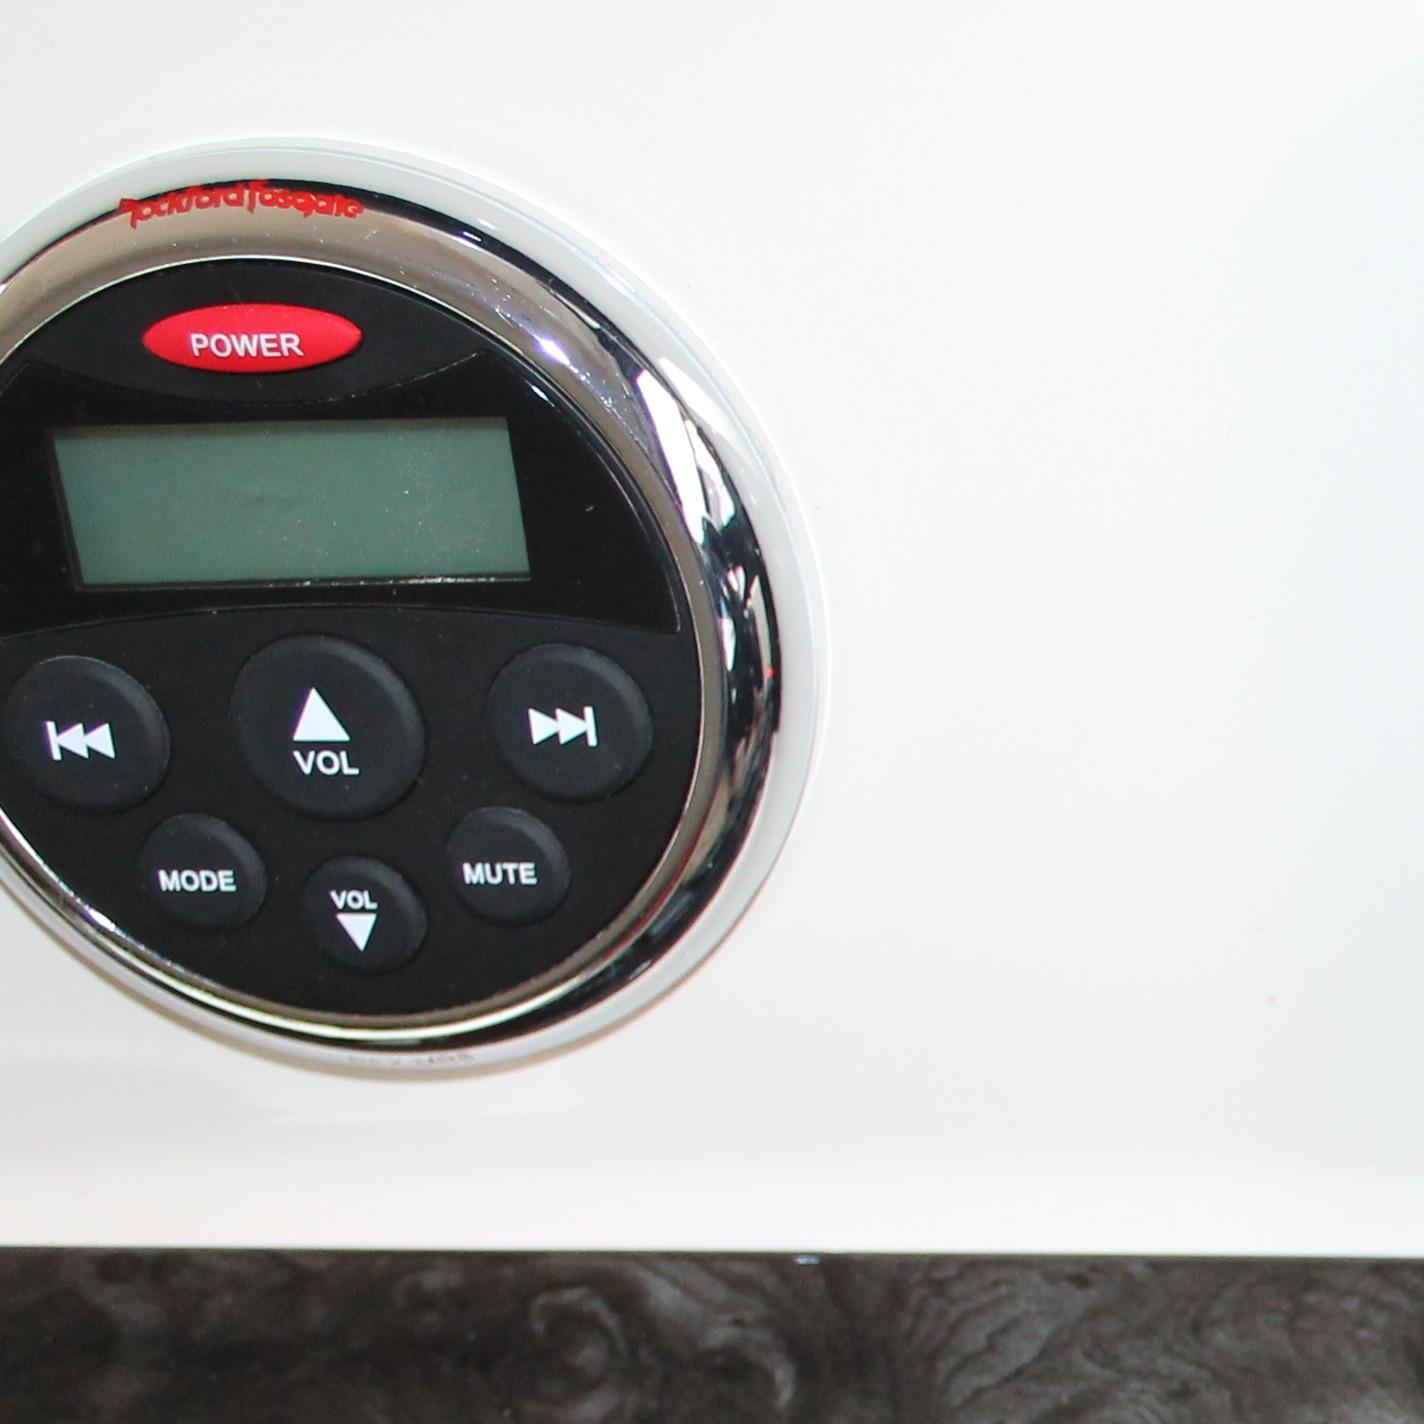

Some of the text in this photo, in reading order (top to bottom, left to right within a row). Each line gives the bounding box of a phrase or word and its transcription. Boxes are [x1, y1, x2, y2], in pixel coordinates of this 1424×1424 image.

[190, 331, 304, 360] POWER
[293, 750, 359, 776] VOL
[159, 868, 236, 893] MODE
[462, 861, 537, 886] MUTE
[331, 890, 377, 911] VOL
